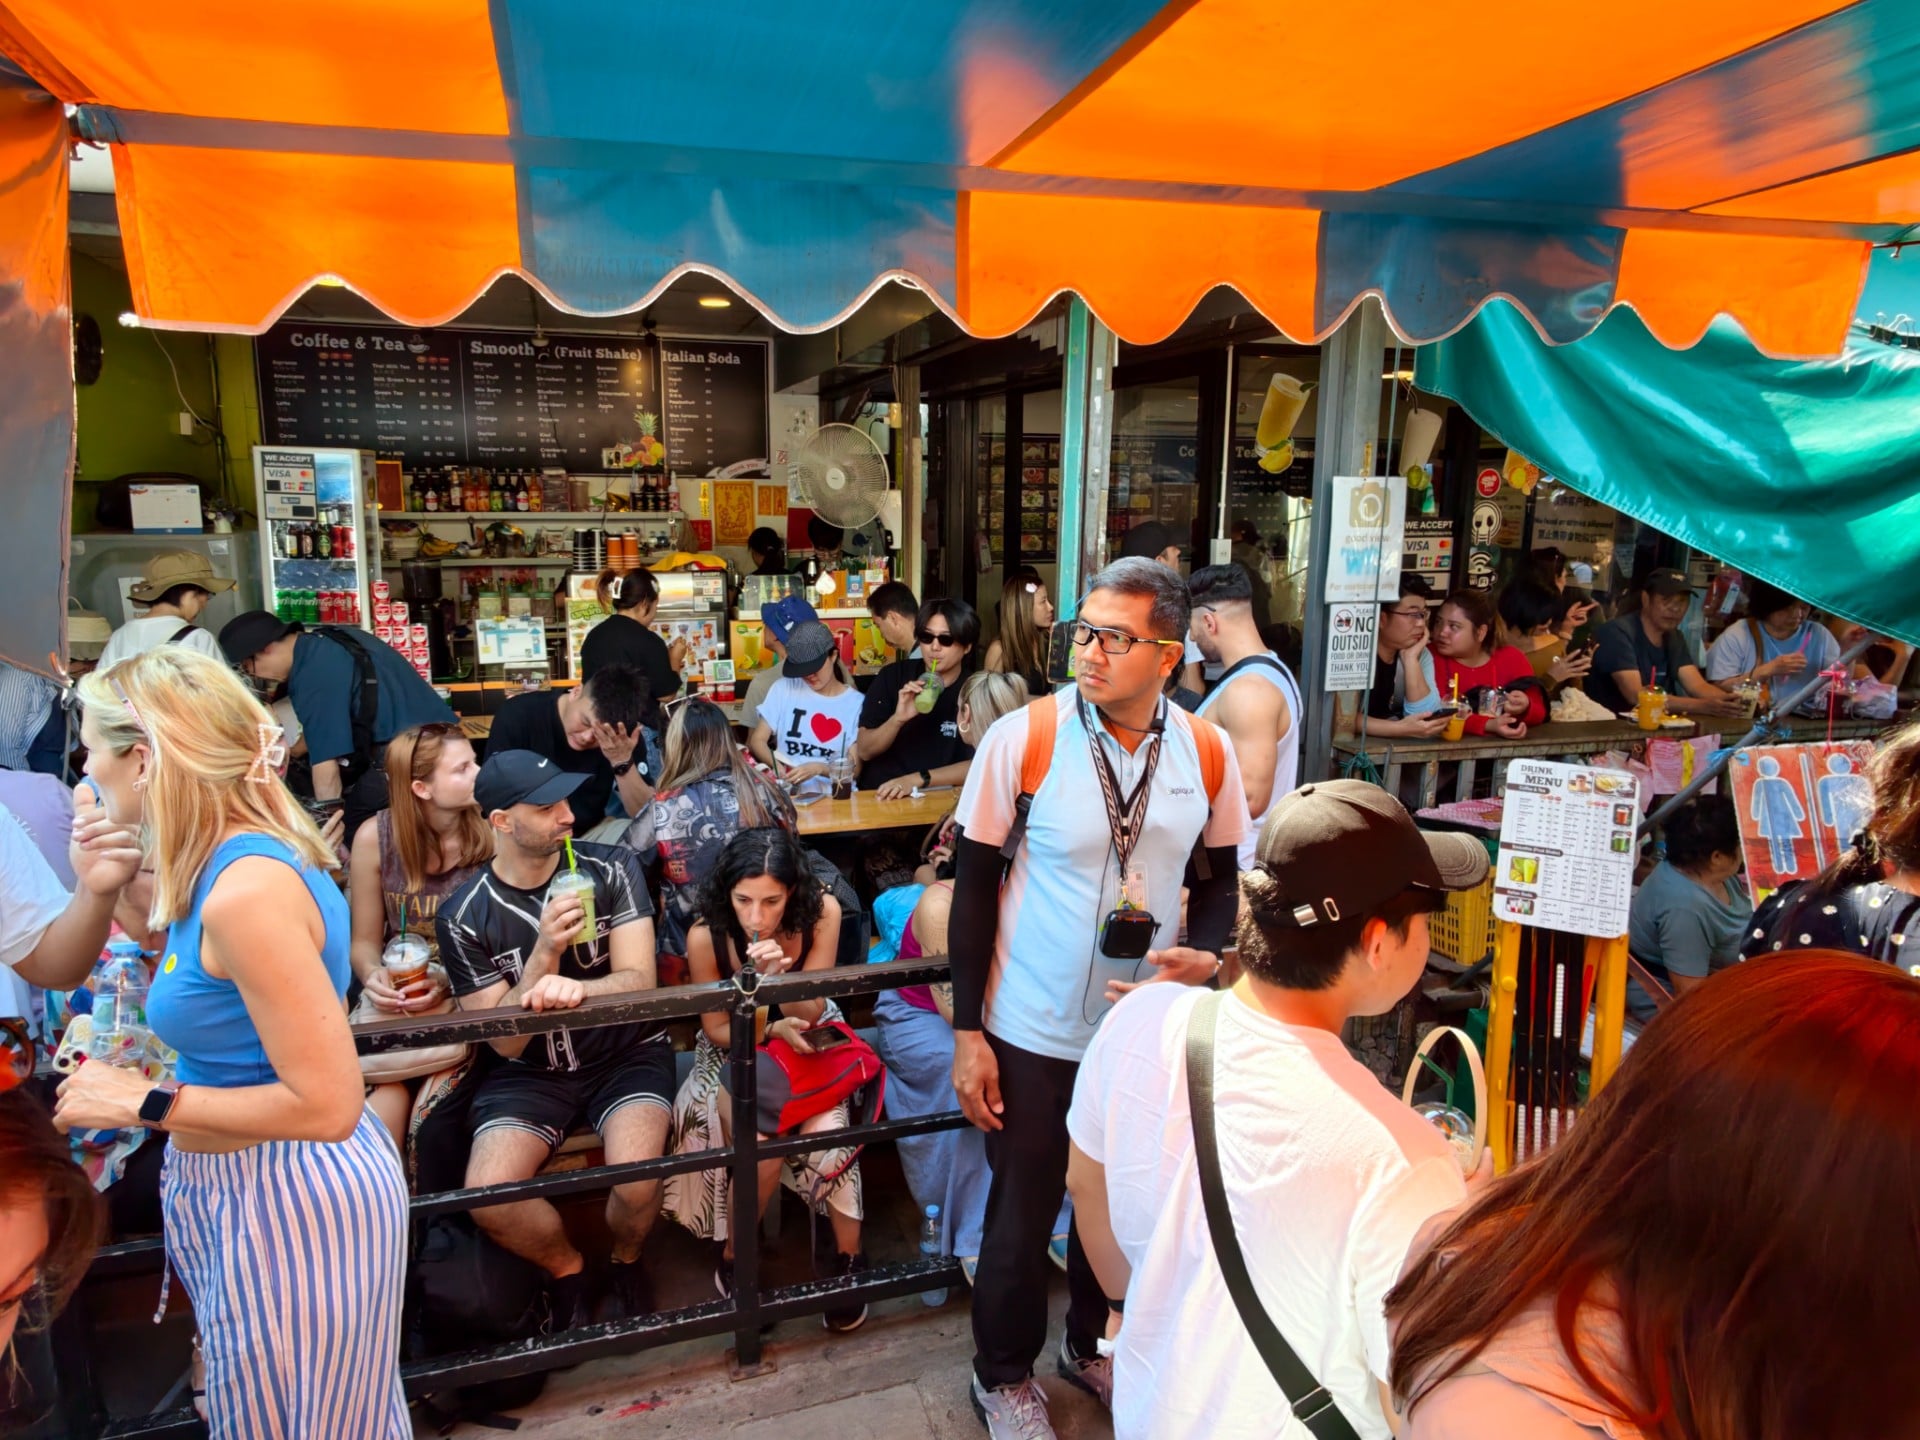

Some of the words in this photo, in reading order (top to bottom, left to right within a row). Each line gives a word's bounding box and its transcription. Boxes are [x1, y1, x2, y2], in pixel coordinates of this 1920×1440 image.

[290, 333, 349, 348] Coffee
[354, 336, 366, 349] &
[371, 336, 405, 351] Tea
[554, 346, 592, 359] (Fruit
[595, 347, 642, 361] Shake)
[661, 350, 705, 363] Italian
[708, 352, 741, 364] Soda
[267, 469, 291, 478] VISA
[1405, 521, 1419, 530] WE
[1420, 520, 1453, 529] ACCEPT
[1406, 540, 1430, 551] VISA
[1355, 616, 1374, 632] NO
[1331, 634, 1369, 651] OUTSID
[1330, 652, 1345, 660] FOOD
[1330, 663, 1353, 672] THANK
[786, 707, 807, 738] I
[1520, 764, 1553, 775] DRINK
[1524, 774, 1564, 787] MENU
